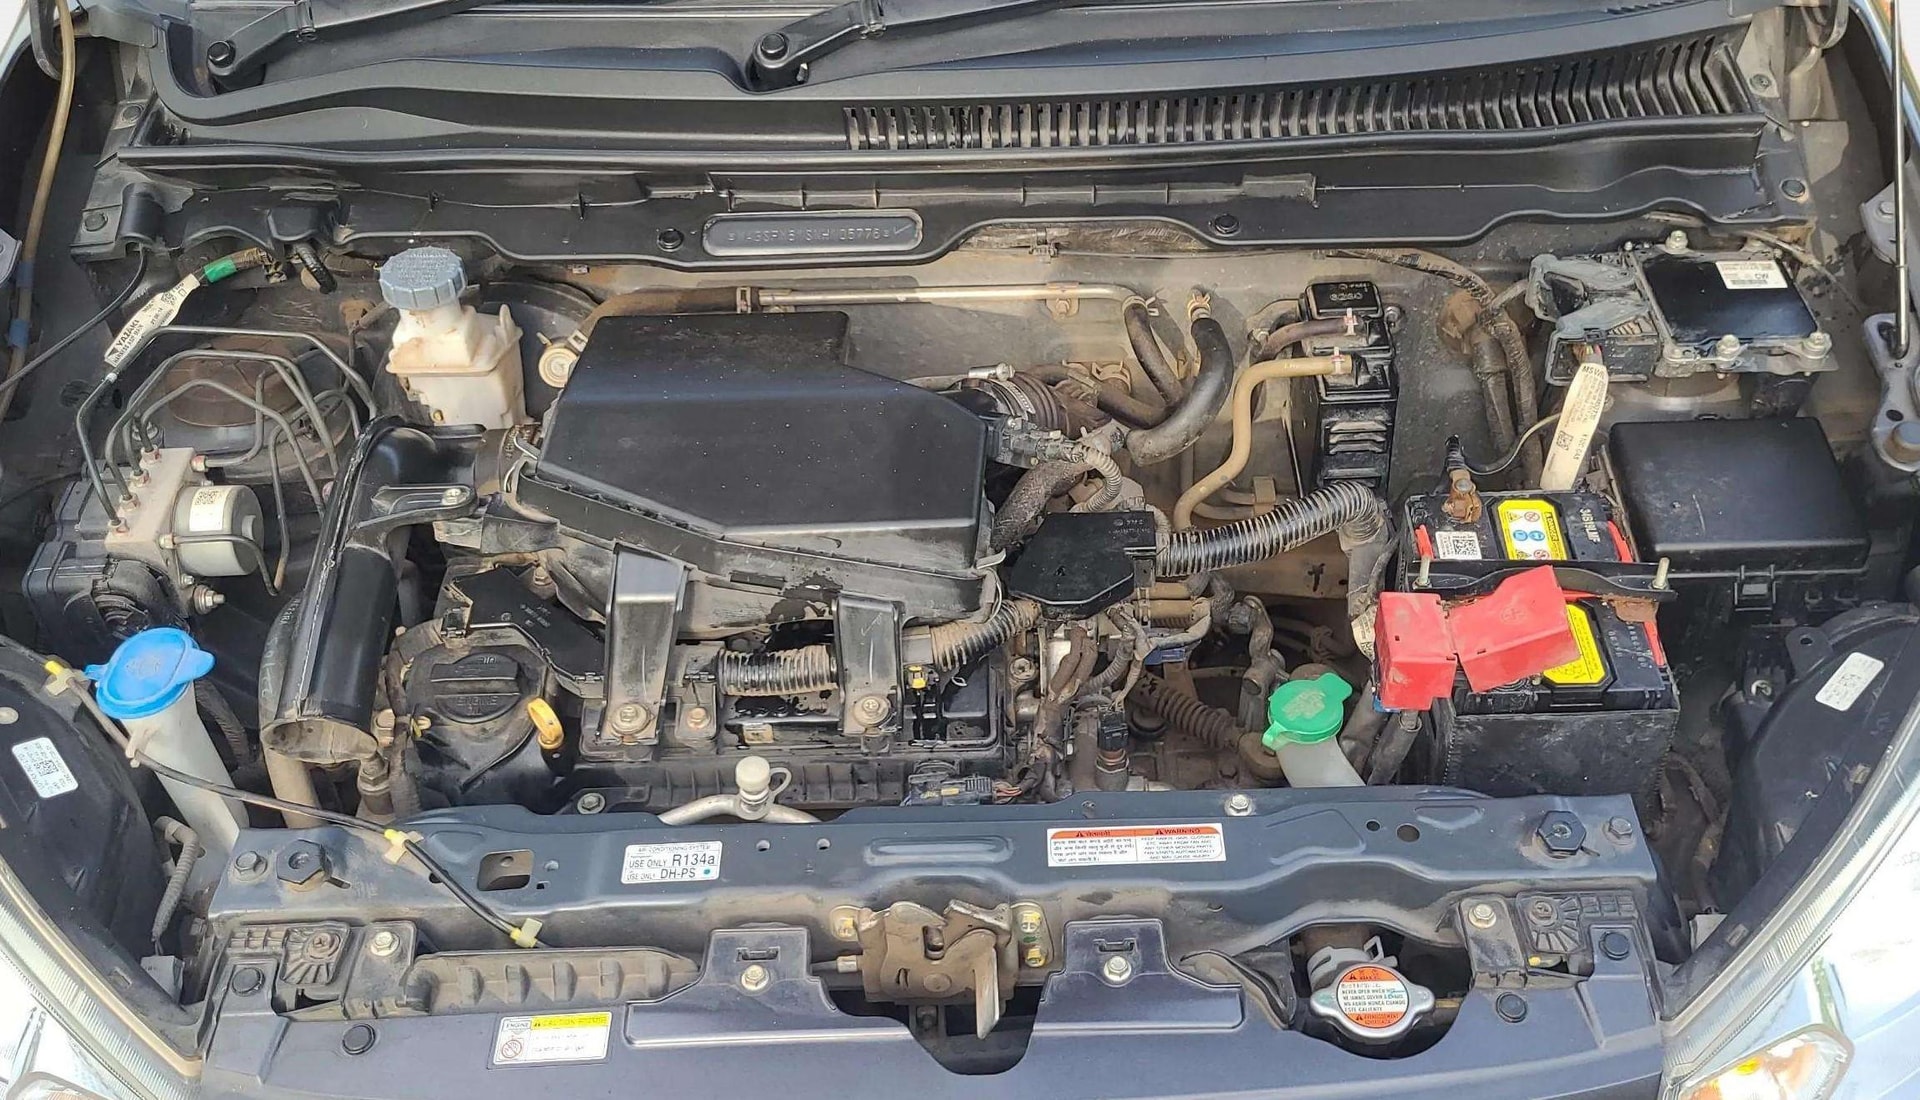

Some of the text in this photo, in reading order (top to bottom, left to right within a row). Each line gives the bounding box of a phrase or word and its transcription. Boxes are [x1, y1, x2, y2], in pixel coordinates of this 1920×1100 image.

[116, 319, 140, 347] YAZAKI
[629, 853, 715, 868] USE ONLY R134a
[660, 868, 696, 879] DH-PS
